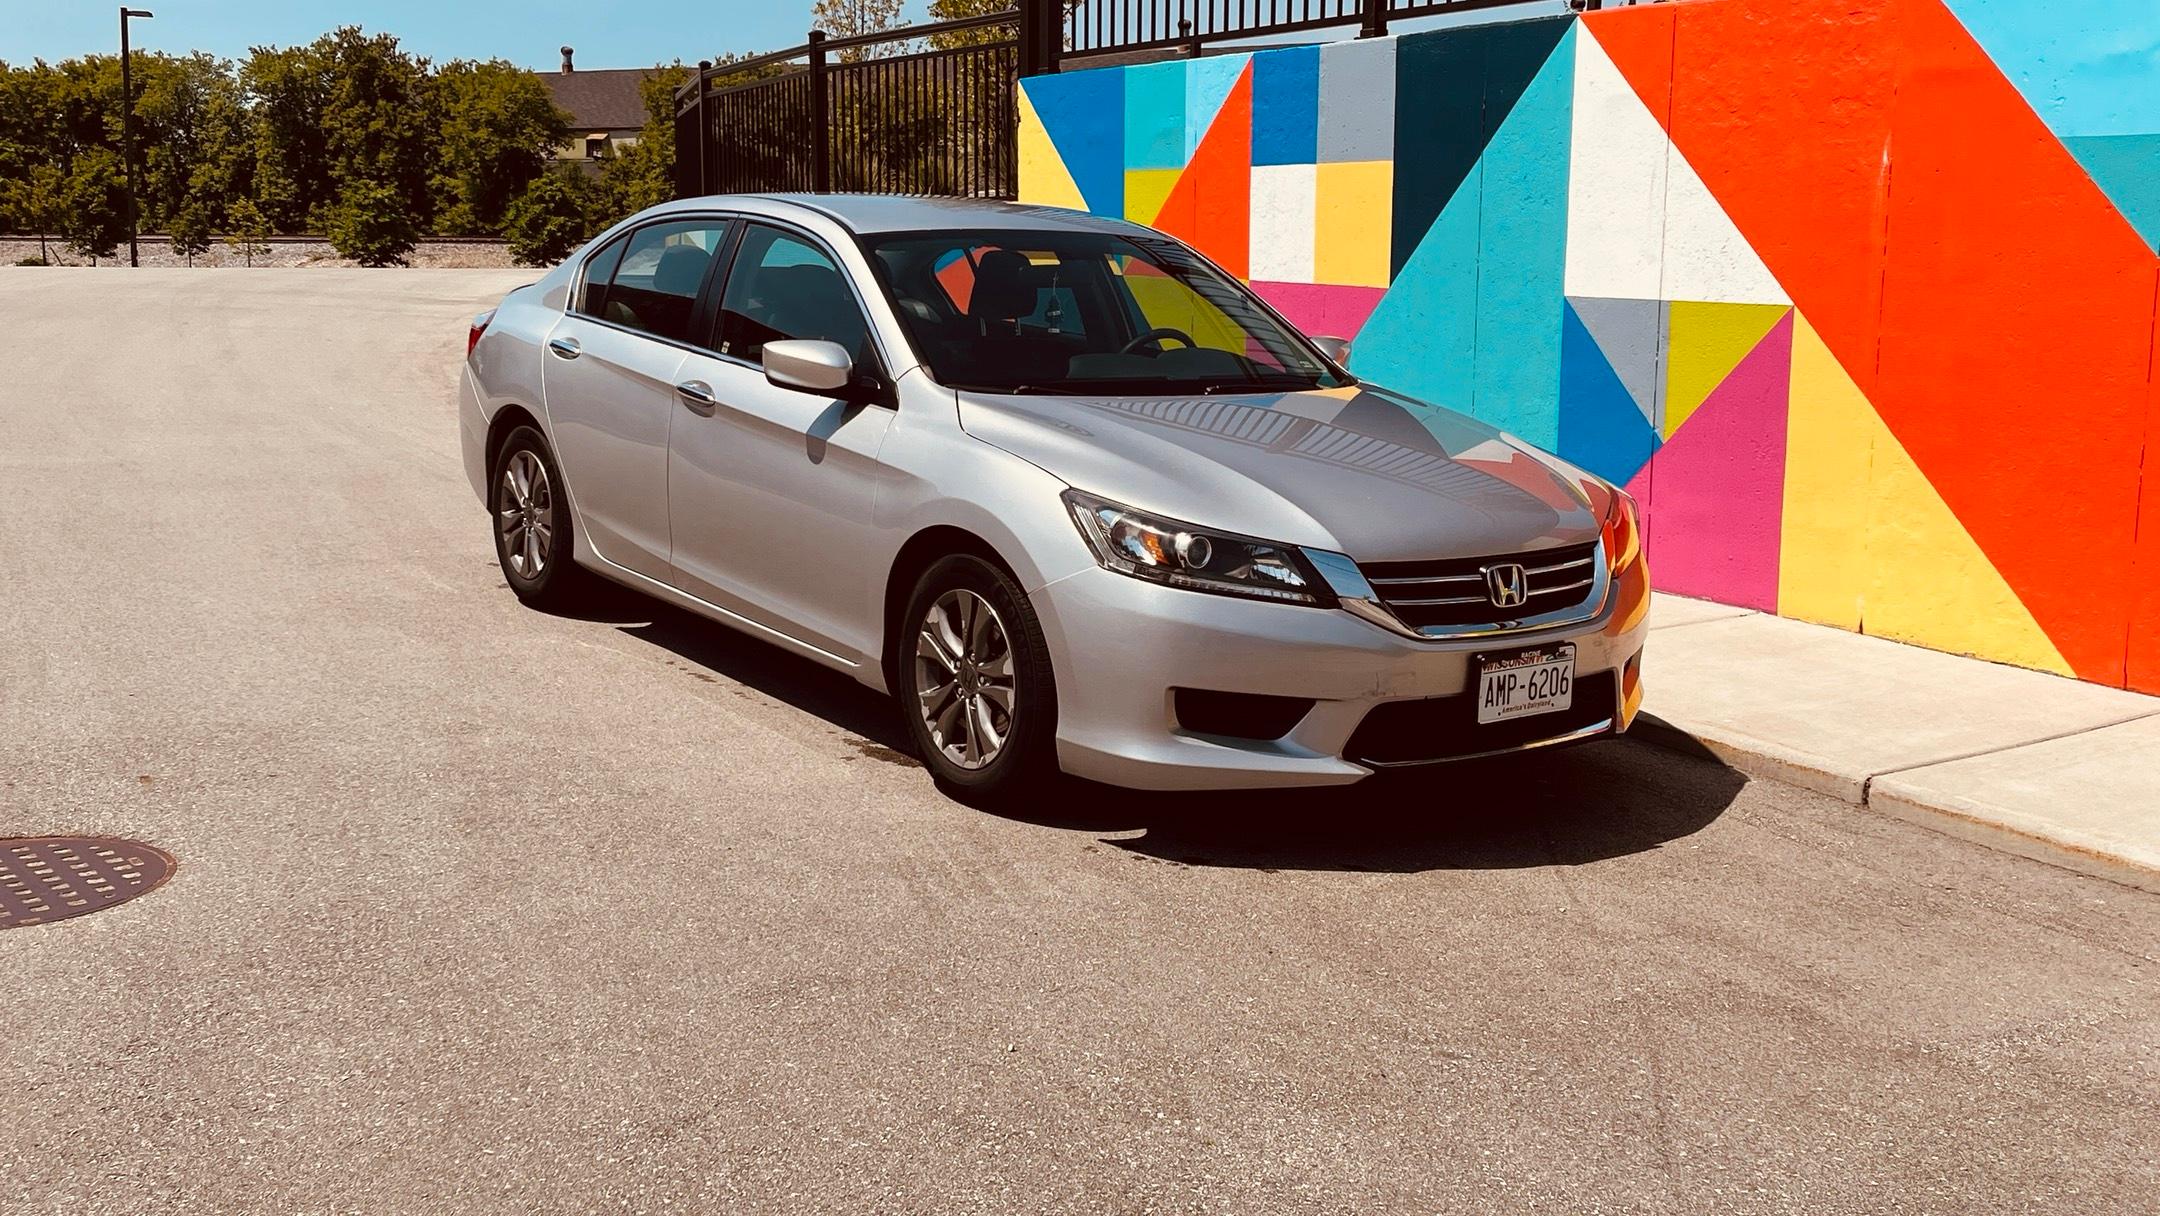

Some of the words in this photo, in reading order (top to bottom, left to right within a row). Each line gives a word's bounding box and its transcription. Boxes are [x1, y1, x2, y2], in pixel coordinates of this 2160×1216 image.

[1485, 665, 1569, 708] AMP-6206
[1502, 703, 1526, 713] America's
[1527, 699, 1552, 710] Dairyland
